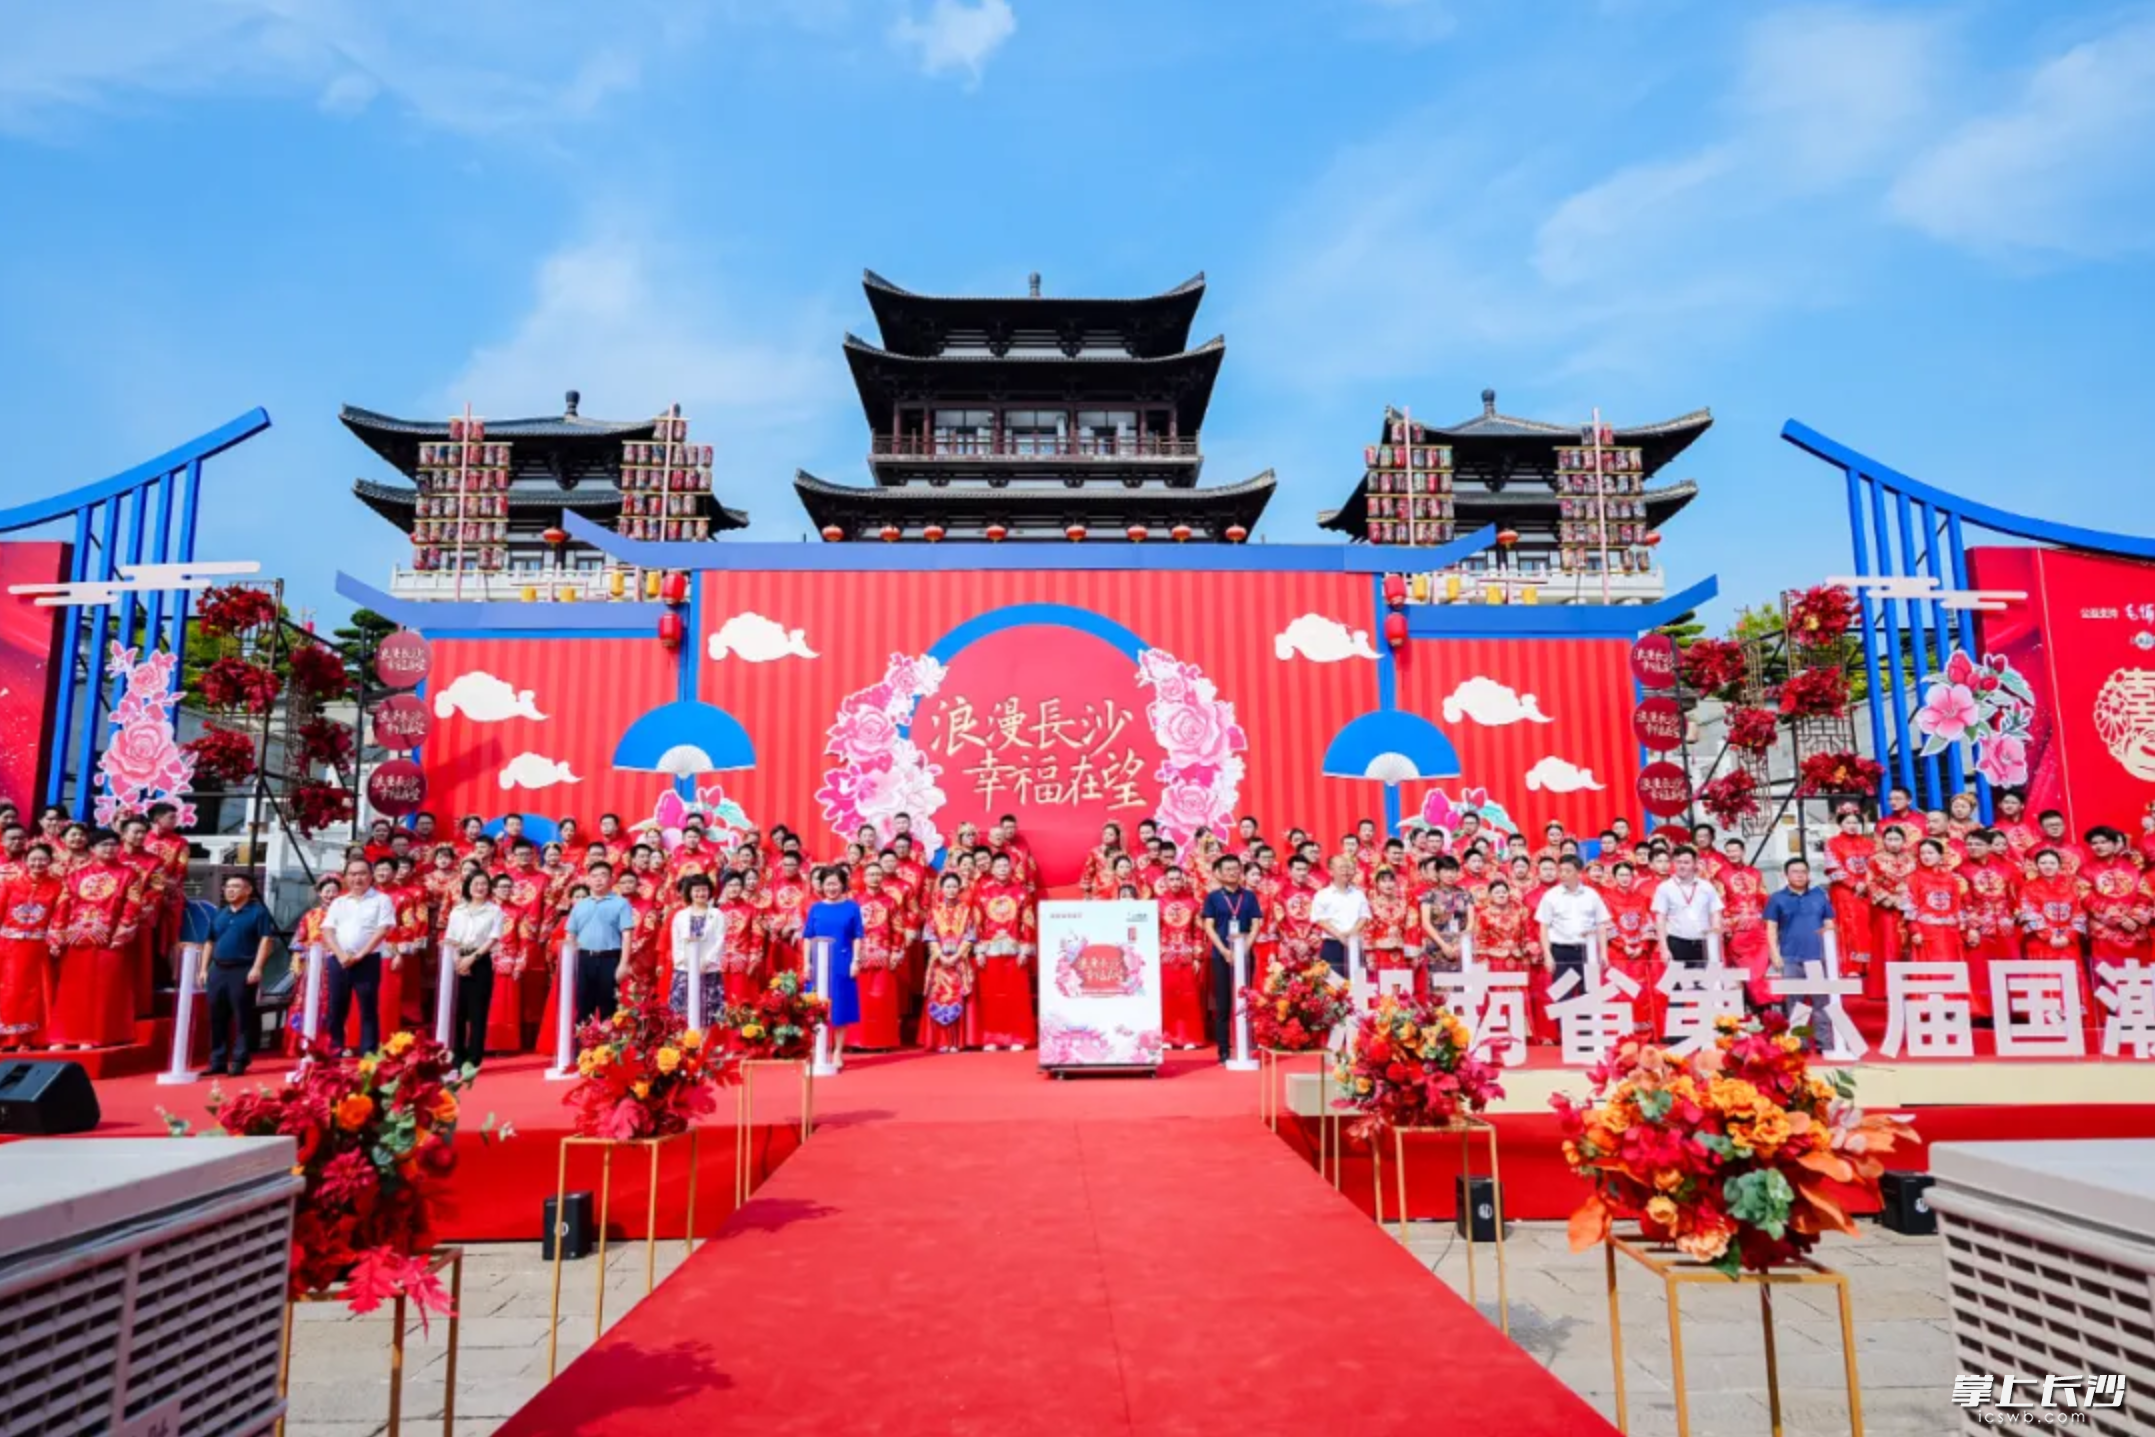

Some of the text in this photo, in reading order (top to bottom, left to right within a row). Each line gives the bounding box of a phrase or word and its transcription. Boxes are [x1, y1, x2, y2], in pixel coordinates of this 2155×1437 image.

[930, 695, 1134, 757] 浪漫長沙
[962, 748, 1148, 813] 幸福在望
